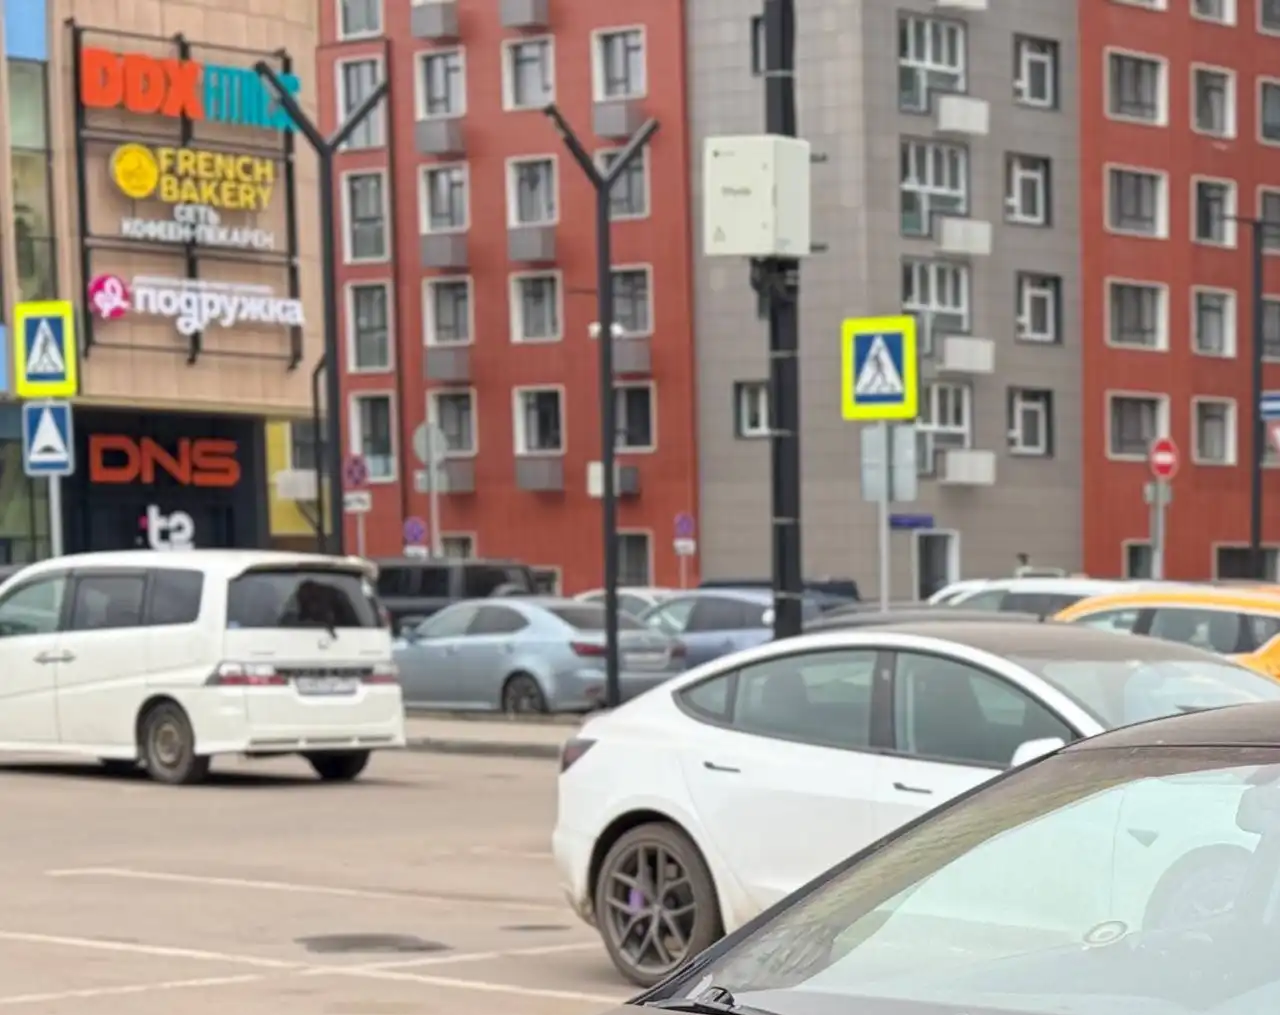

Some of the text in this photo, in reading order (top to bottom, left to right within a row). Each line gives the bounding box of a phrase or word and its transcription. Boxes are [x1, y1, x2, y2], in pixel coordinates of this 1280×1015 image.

[81, 47, 205, 121] DDX
[158, 147, 275, 182] FRENCH
[160, 175, 274, 209] BAKERY
[135, 286, 305, 335] подружка
[90, 434, 241, 487] DNS
